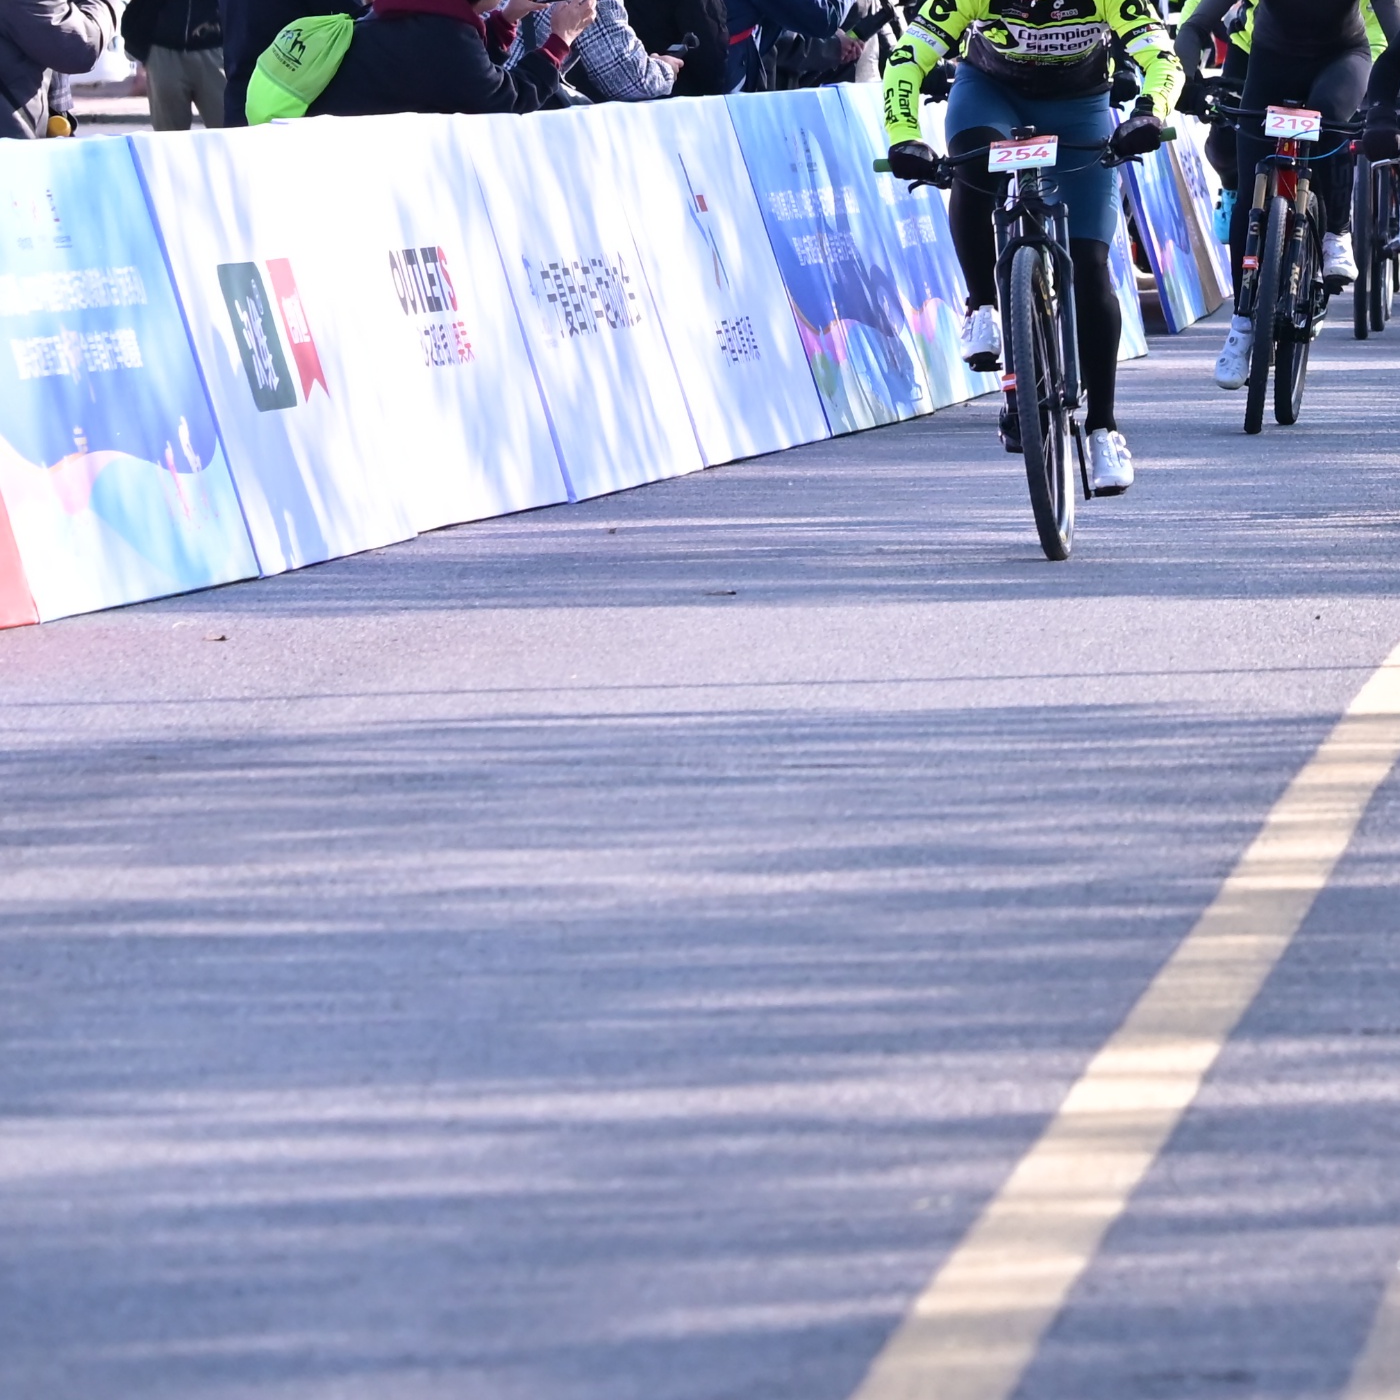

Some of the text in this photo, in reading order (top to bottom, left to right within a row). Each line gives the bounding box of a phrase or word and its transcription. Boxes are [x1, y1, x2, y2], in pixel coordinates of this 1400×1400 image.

[1018, 26, 1101, 42] Champion
[1025, 37, 1093, 52] System
[1271, 116, 1315, 131] 219
[997, 147, 1050, 163] 254
[388, 245, 458, 316] OUTLETS
